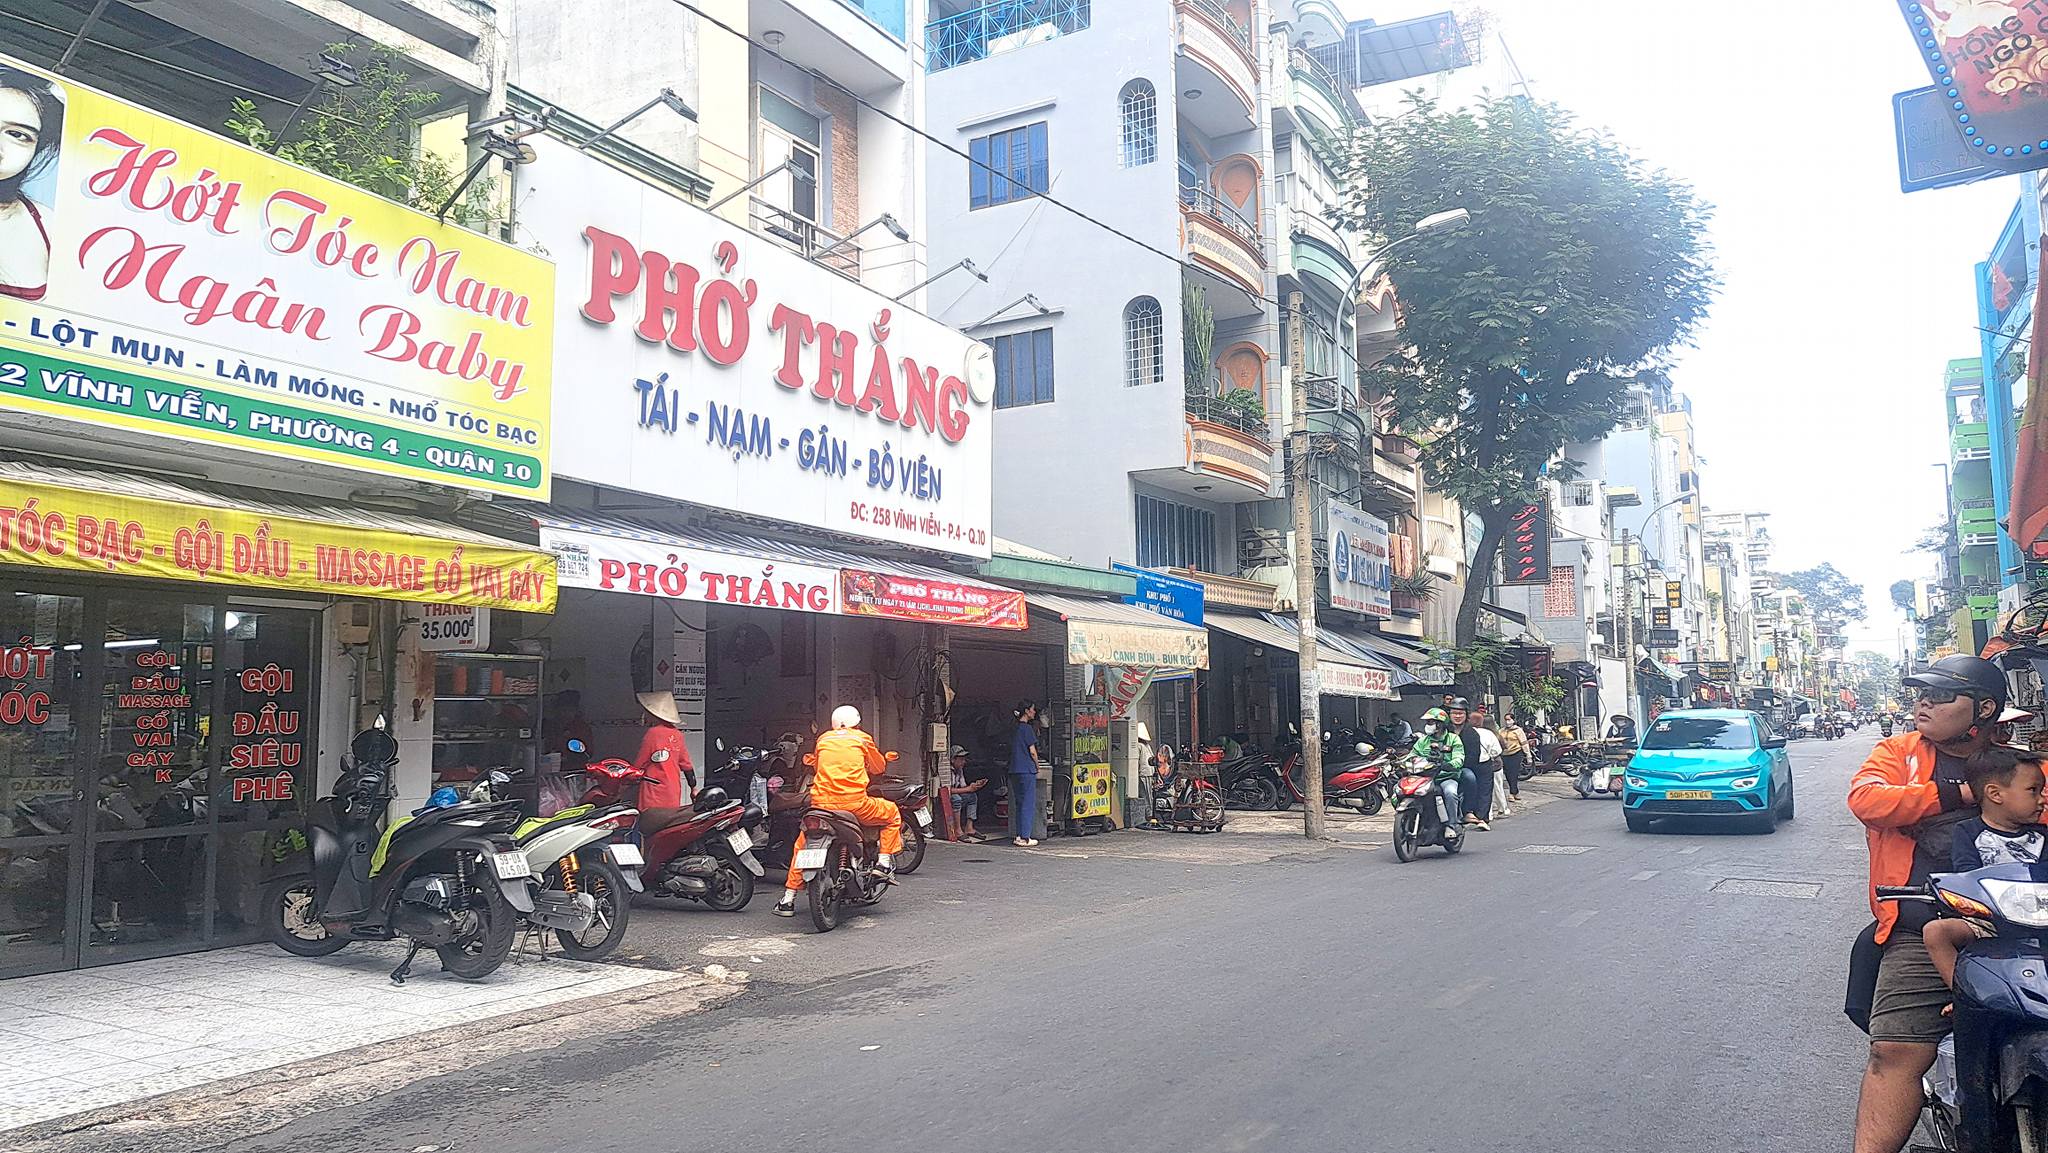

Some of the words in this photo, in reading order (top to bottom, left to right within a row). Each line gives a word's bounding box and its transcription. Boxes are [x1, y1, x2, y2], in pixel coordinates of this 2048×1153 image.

[88, 127, 241, 235] Hớt
[266, 189, 380, 279] Tóc
[395, 236, 532, 327] Nam
[78, 226, 332, 341] Ngân
[359, 304, 529, 401] Baby
[579, 224, 758, 366] PHỞ
[768, 303, 971, 443] THẮNG
[30, 317, 98, 347] LỘT
[111, 335, 184, 367] MỤN
[215, 358, 278, 388] LÀM
[288, 374, 364, 407] MÓNG
[389, 398, 439, 422] NHỔ
[445, 411, 489, 434] TÓC
[496, 422, 538, 446] BẠC
[40, 368, 133, 407] VĨNH
[145, 389, 238, 429] VIỄN,
[249, 410, 373, 451] PHƯỜNG
[381, 438, 399, 456] 4
[425, 446, 495, 474] QUẬN
[503, 462, 532, 481] 10
[634, 371, 680, 433] TÁI
[706, 400, 772, 463] NẠM
[868, 441, 895, 491] BÒ
[899, 454, 942, 501] VIÊN
[851, 501, 869, 522] ĐC:
[872, 506, 891, 526] 258
[948, 523, 961, 541] P.4
[968, 528, 986, 545] Q.10
[0, 498, 66, 556] TÓC
[76, 515, 145, 570] BẠC
[174, 518, 224, 578] GỘI
[232, 520, 290, 578] ĐẦU
[315, 544, 426, 592] MASSAGE
[433, 544, 464, 594] CỔ
[470, 563, 502, 599] VAI
[509, 563, 545, 603] GÁY
[598, 553, 689, 596] PHỞ
[700, 565, 830, 612] THẮNG
[137, 650, 177, 668] GỘI
[1113, 650, 1136, 663] CANH
[1138, 650, 1155, 663] BÚN
[1162, 652, 1179, 664] BÚN
[131, 672, 180, 690] ĐẦU
[241, 662, 293, 696] GỘI
[1364, 671, 1387, 691] 252
[0, 683, 50, 725] ÓC
[119, 695, 192, 708] MASSAGE
[233, 702, 299, 736] ĐẦU
[133, 732, 171, 746] VAI
[230, 737, 301, 769] SIÊU
[127, 751, 174, 767] GÁY
[155, 769, 173, 782] K
[233, 771, 293, 802] PHÊ
